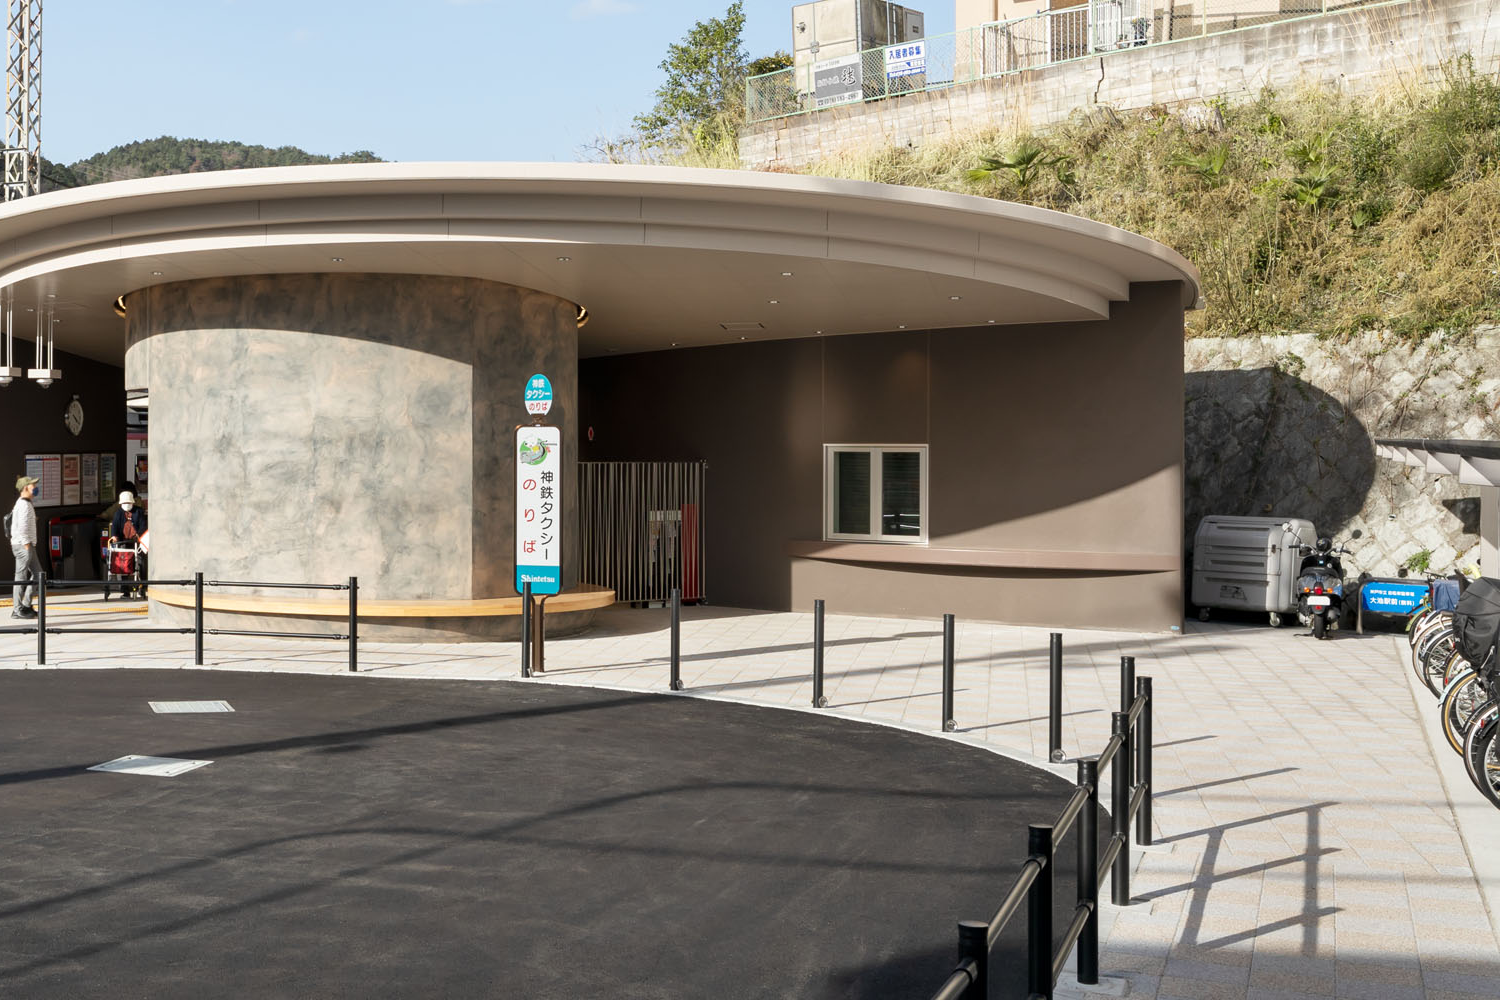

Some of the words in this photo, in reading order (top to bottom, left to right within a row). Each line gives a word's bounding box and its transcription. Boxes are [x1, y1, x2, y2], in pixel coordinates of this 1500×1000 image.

[526, 390, 551, 399] タクシー
[529, 402, 548, 411] のりば
[522, 479, 537, 554] のりば
[540, 471, 554, 561] 神鉄タクシー
[521, 574, 556, 583] Shintetsu
